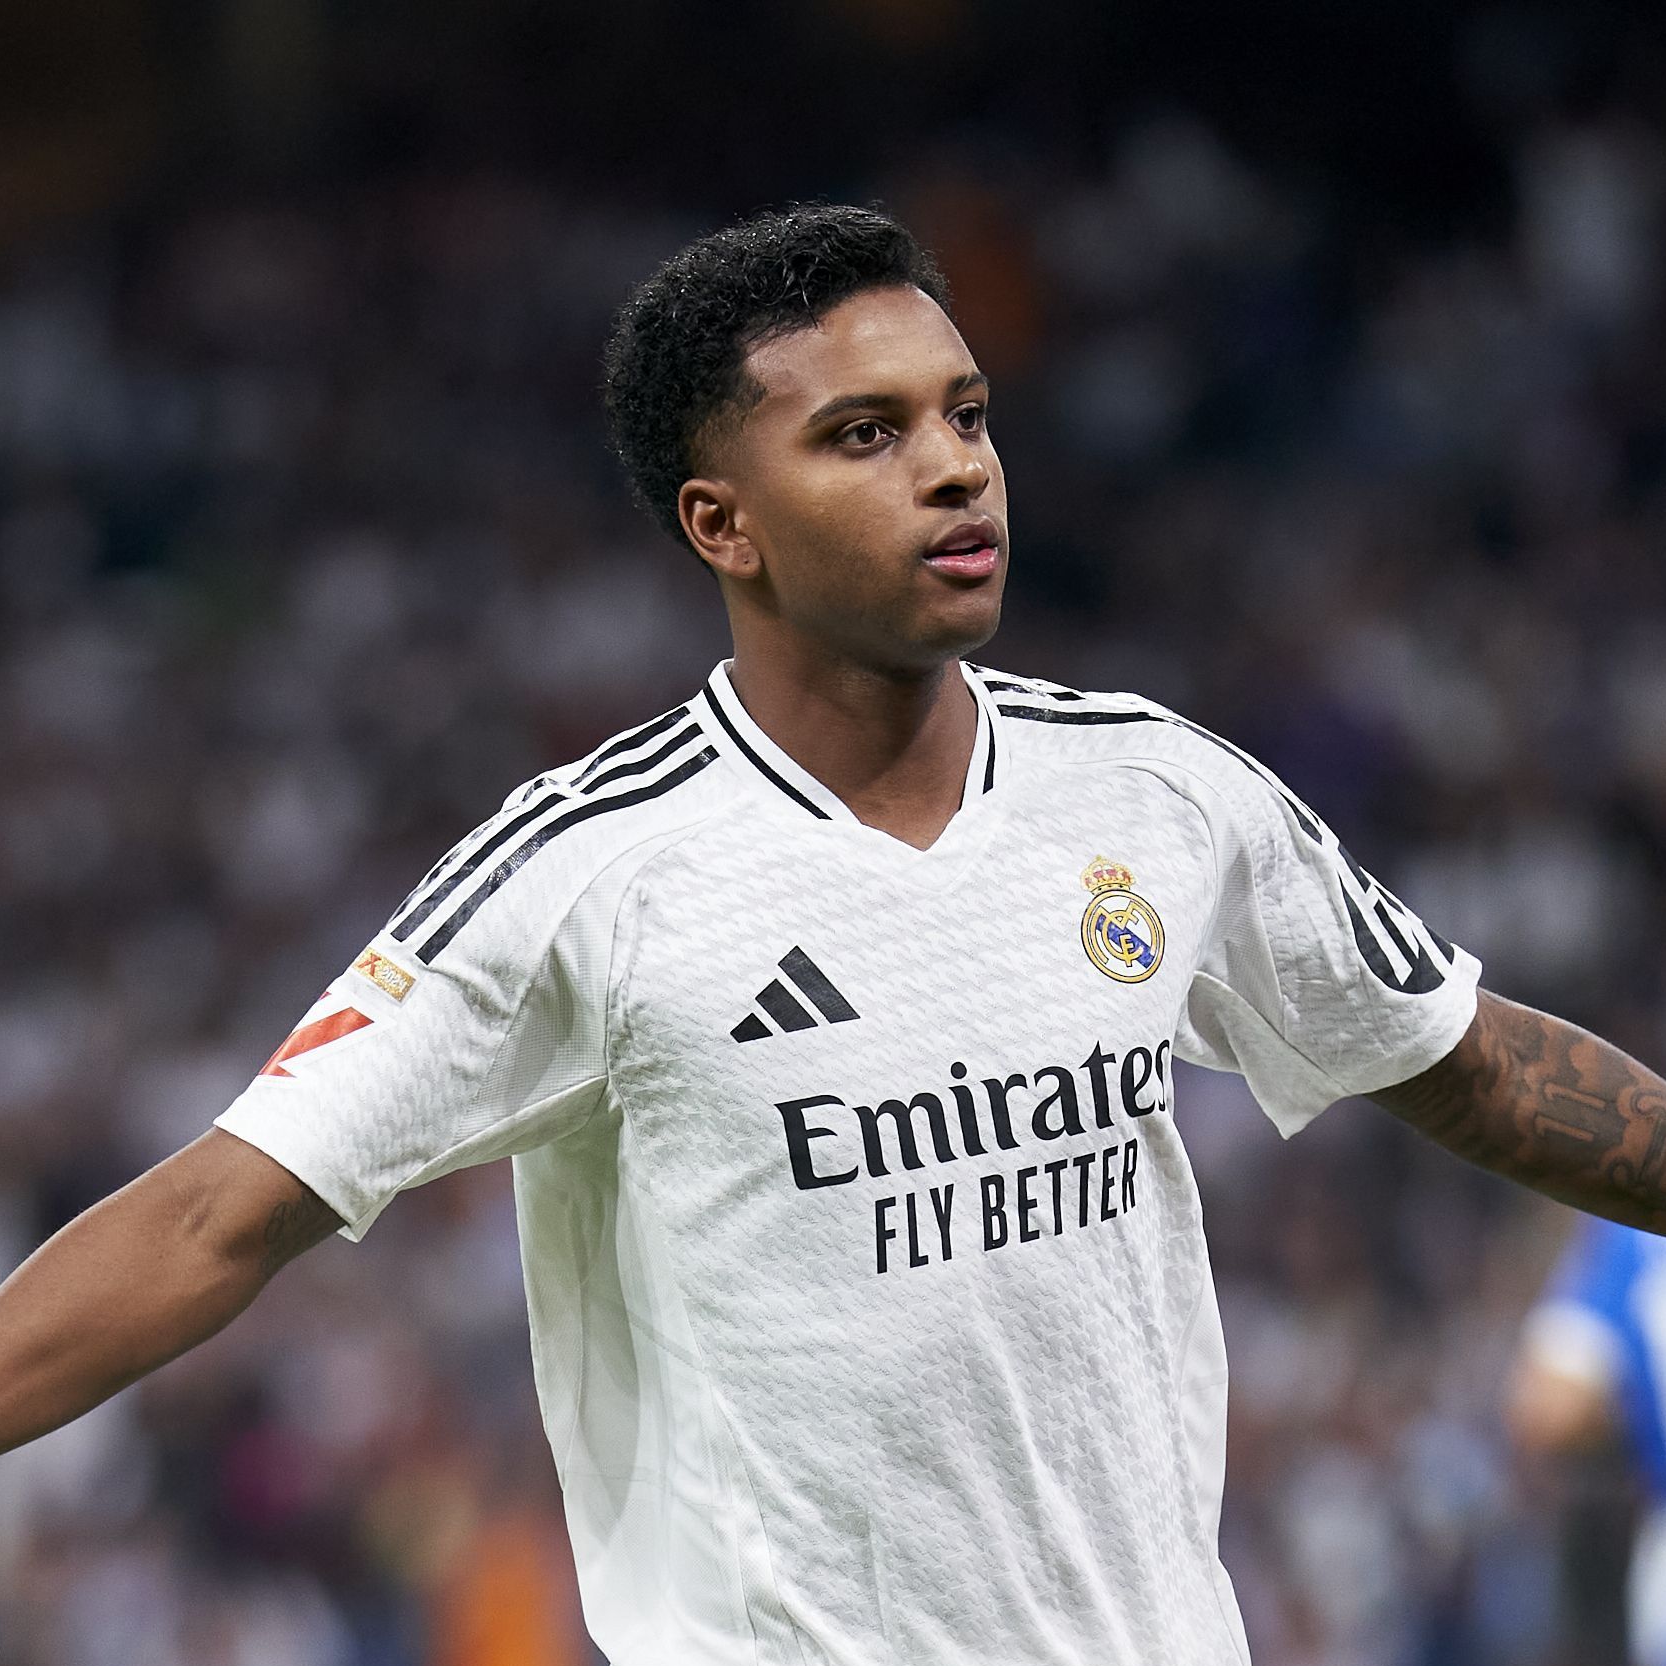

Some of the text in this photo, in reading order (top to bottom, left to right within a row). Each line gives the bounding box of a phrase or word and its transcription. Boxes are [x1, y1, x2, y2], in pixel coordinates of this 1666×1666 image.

[774, 1039, 1170, 1191] Emirates
[874, 1137, 1138, 1275] FLY BETTER
